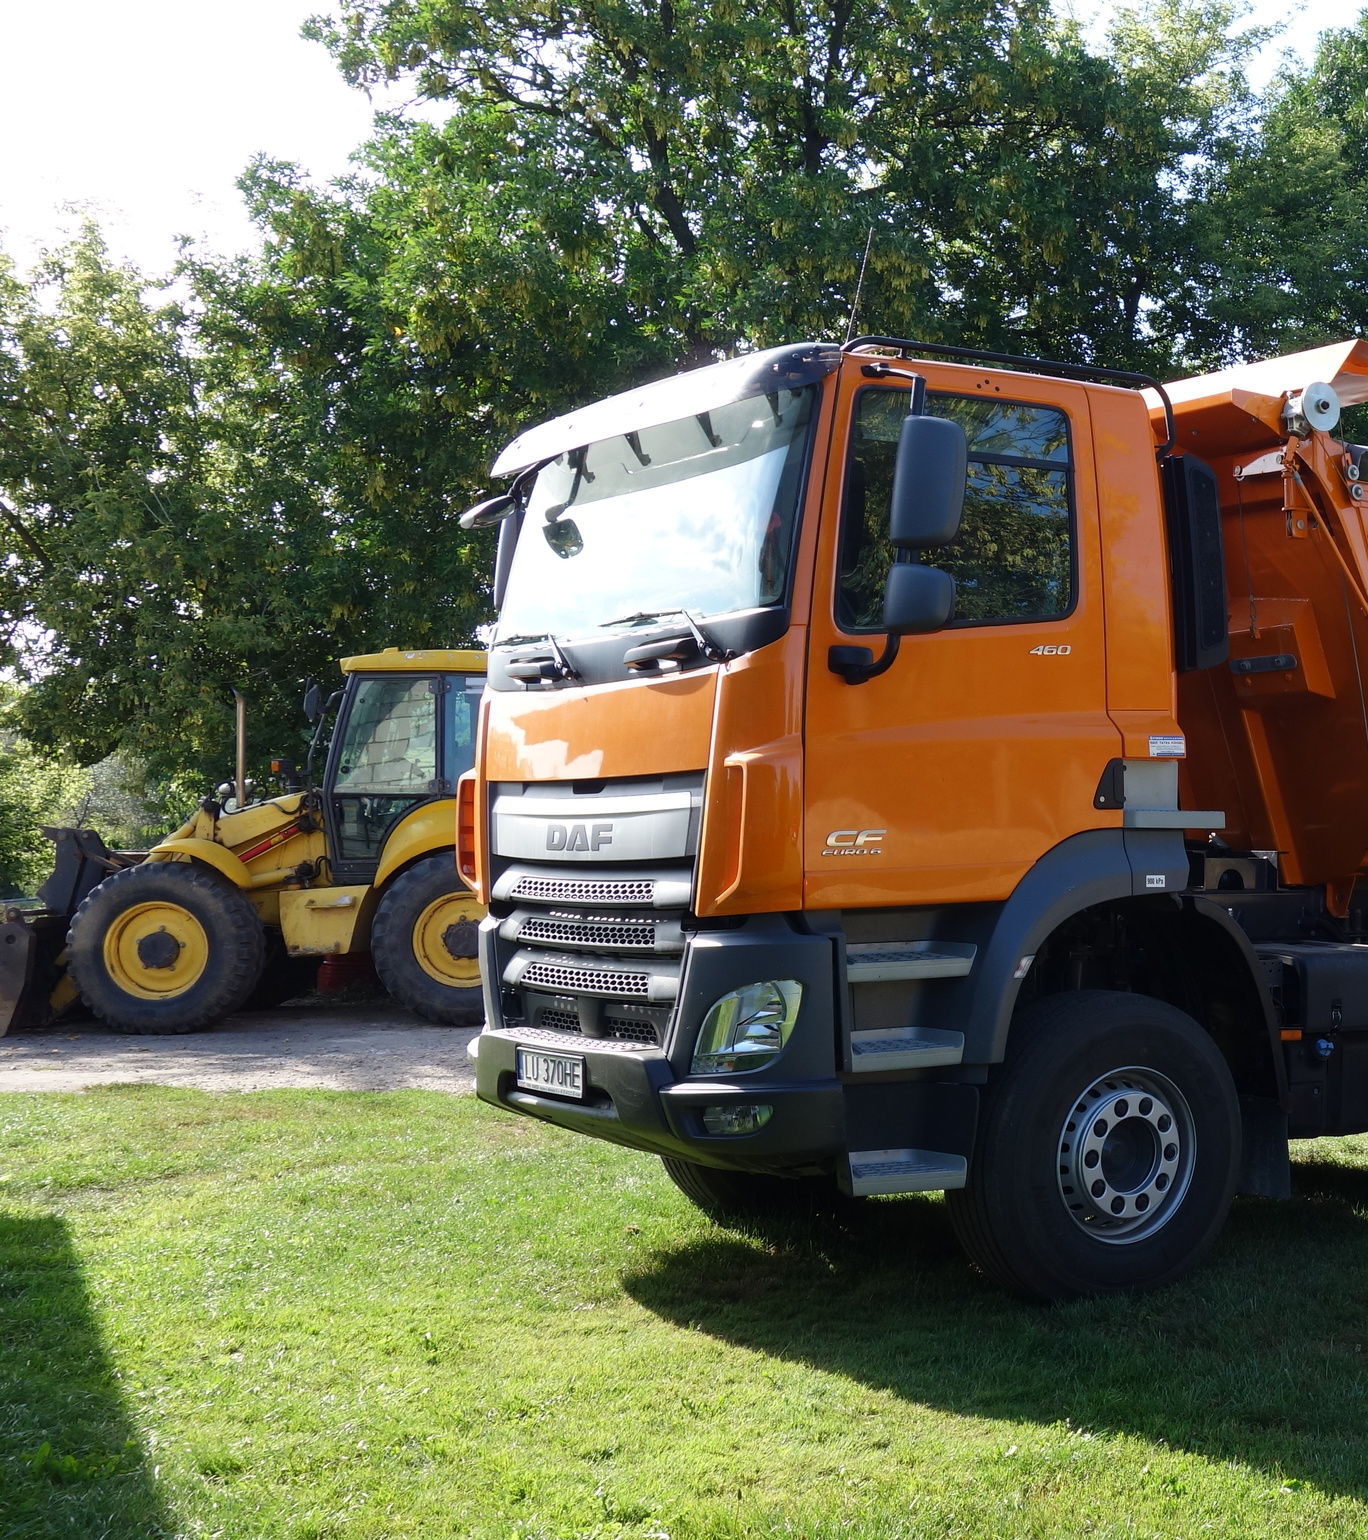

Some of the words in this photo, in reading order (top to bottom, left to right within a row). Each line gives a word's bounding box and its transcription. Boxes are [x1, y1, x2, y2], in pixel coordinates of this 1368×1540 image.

[1029, 645, 1072, 655] 460
[546, 823, 614, 851] DAF
[826, 829, 887, 847] CF
[821, 848, 867, 856] EURO
[869, 847, 881, 855] 6
[525, 1054, 539, 1081] LU
[542, 1057, 581, 1090] 370HE
